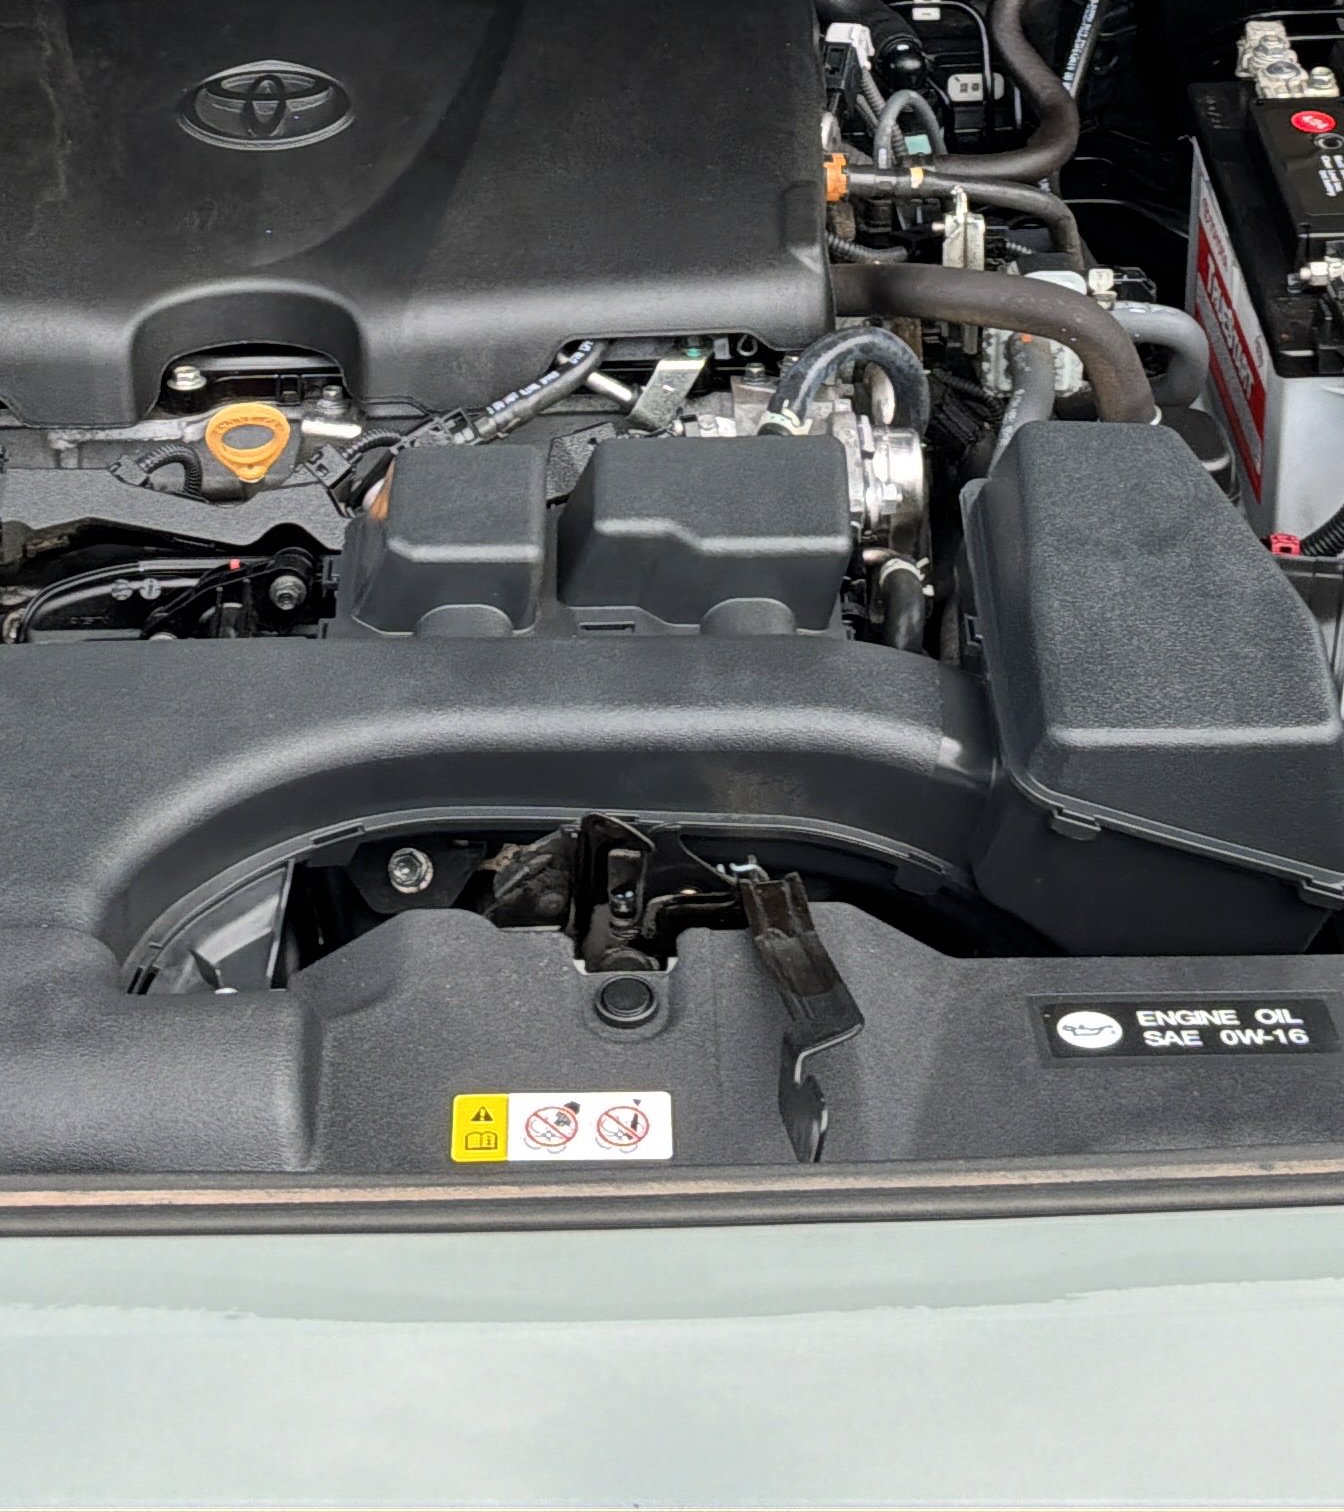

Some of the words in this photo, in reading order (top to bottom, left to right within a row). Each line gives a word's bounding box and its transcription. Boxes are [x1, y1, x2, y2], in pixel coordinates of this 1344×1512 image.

[1136, 1008, 1240, 1027] ENGINE
[1254, 1008, 1304, 1026] OIL
[1142, 1029, 1204, 1047] SAE
[1219, 1028, 1310, 1047] 0W-16
